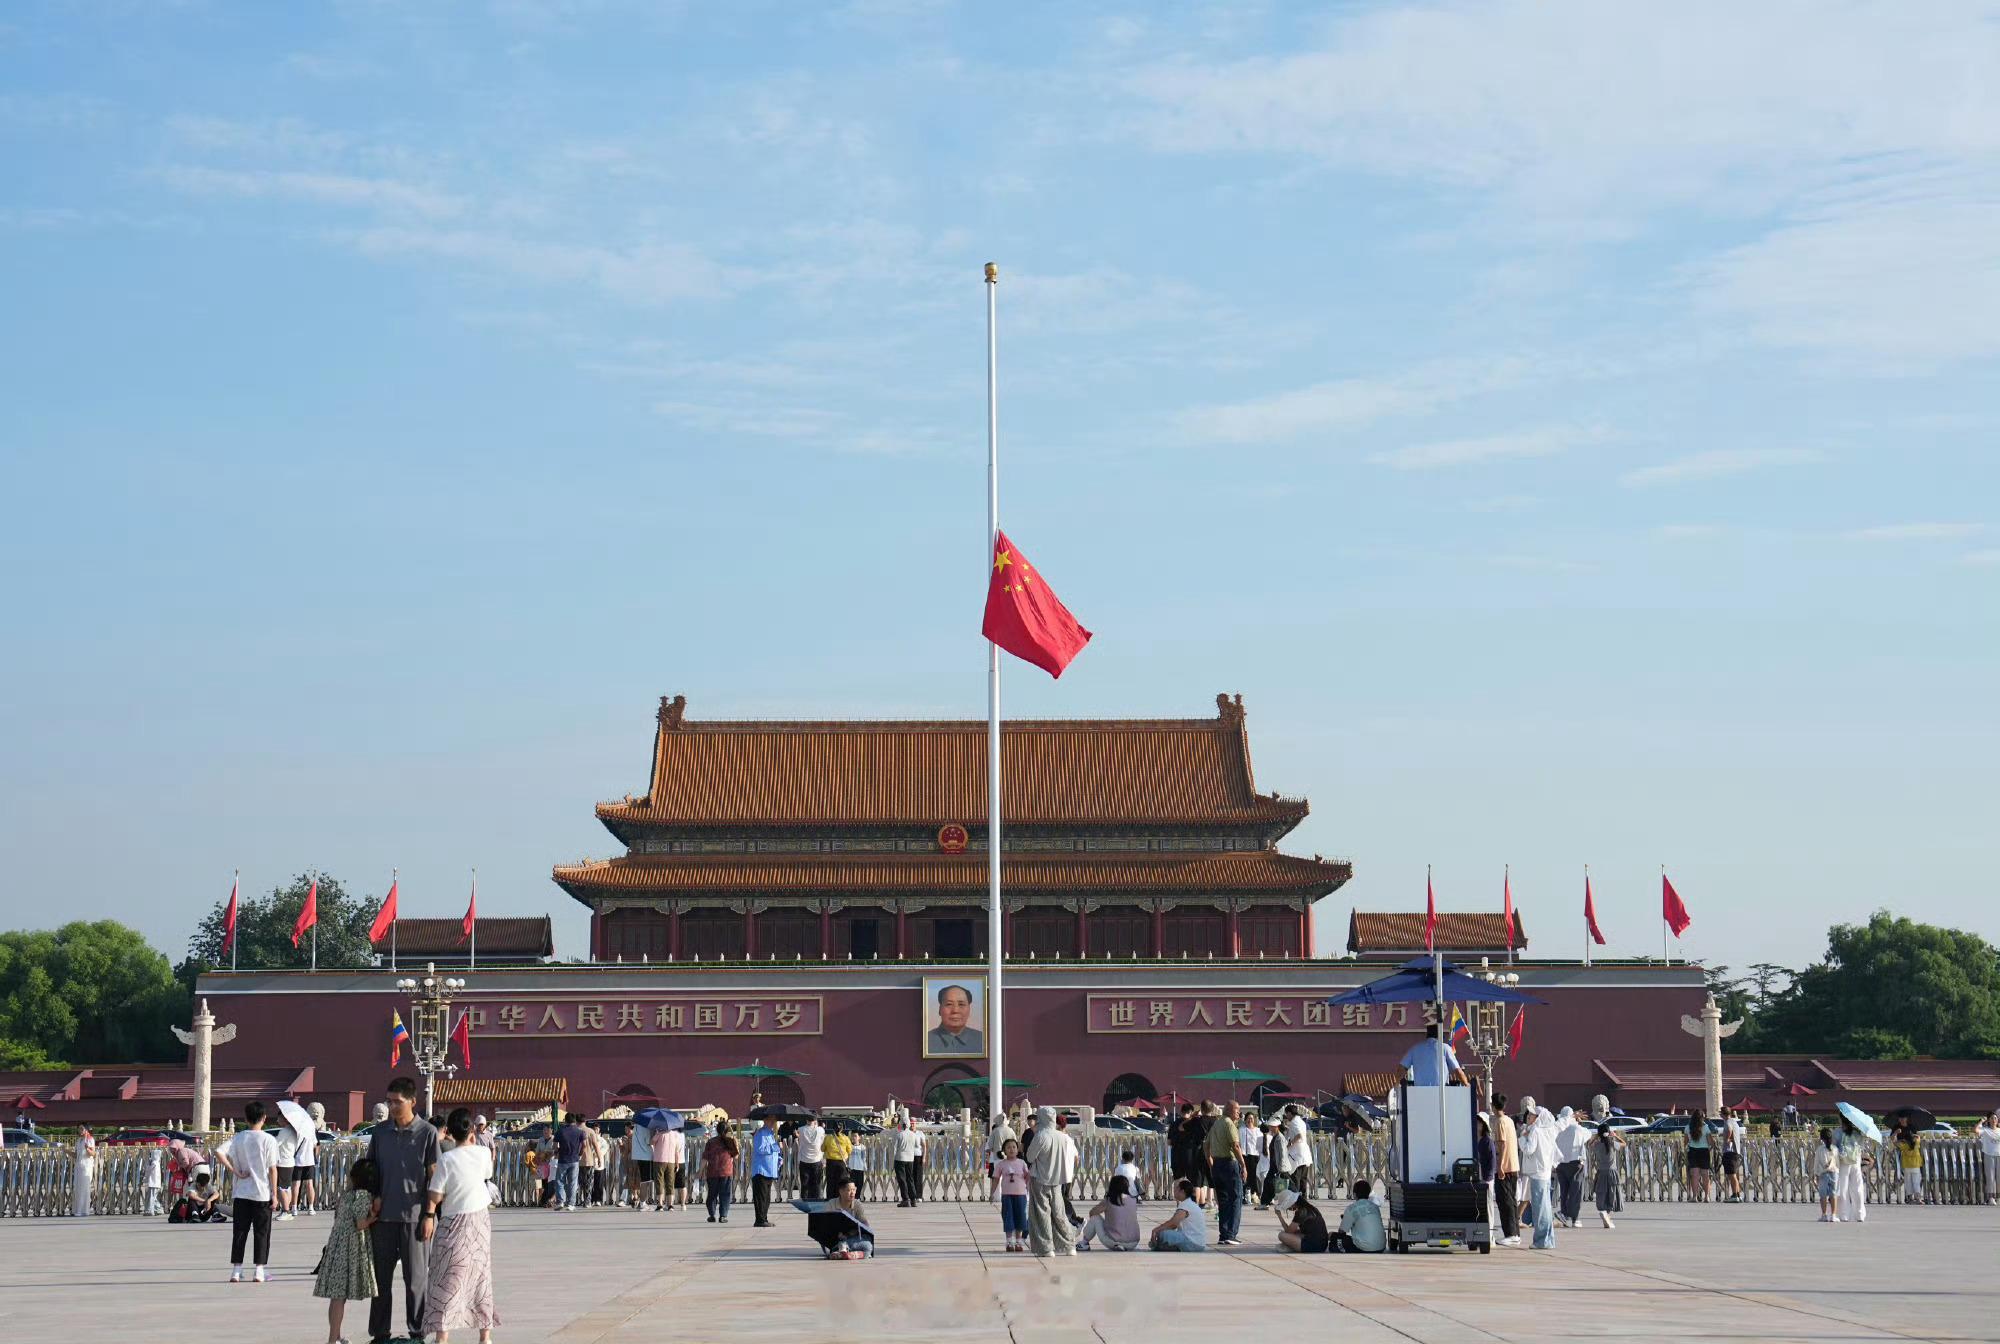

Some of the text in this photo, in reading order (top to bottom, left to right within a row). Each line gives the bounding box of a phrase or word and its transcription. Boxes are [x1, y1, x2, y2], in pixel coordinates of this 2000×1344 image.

[458, 1003, 801, 1030] 中华人民共和国万岁
[1109, 1000, 1448, 1026] 世界人民大团结万岁
